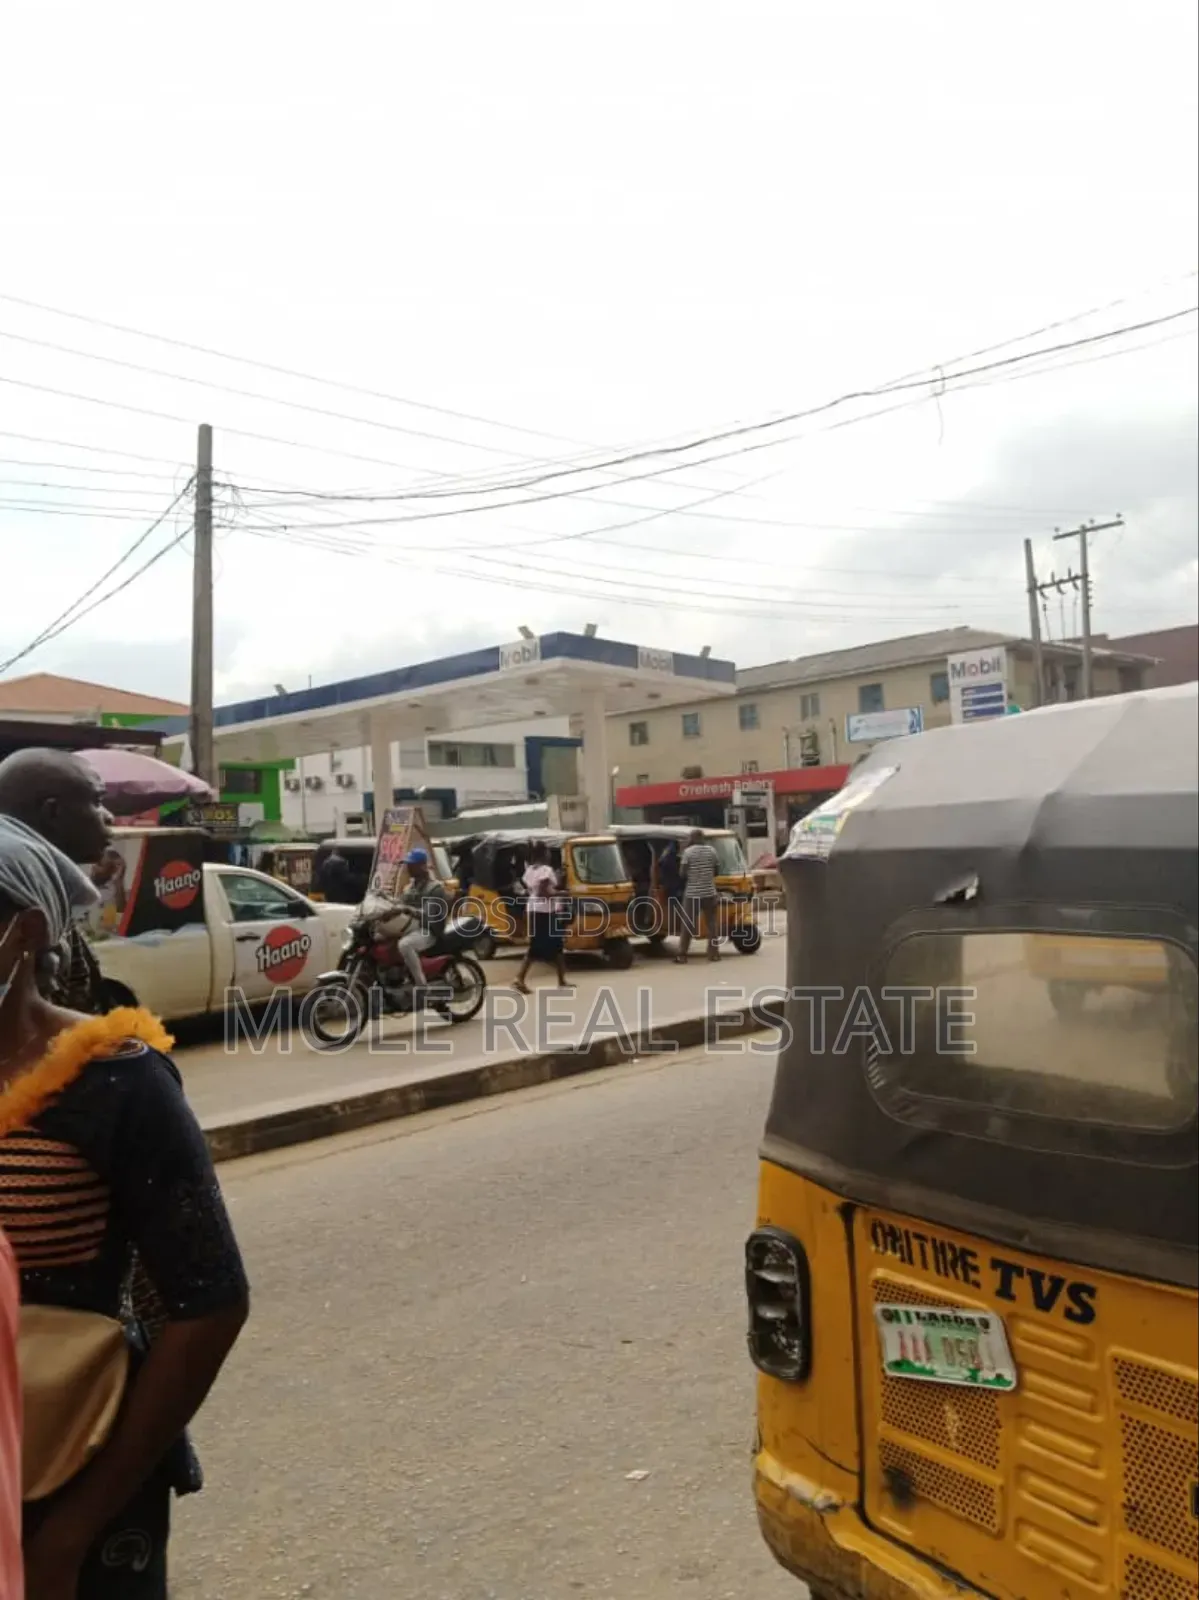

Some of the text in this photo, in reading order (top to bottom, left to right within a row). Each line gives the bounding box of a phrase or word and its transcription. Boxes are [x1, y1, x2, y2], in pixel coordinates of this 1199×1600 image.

[950, 655, 1002, 680] Mobil
[153, 869, 202, 898] Haano
[256, 933, 311, 972] Haano
[990, 1256, 1097, 1326] TVS
[914, 1310, 978, 1327] LAGOS
